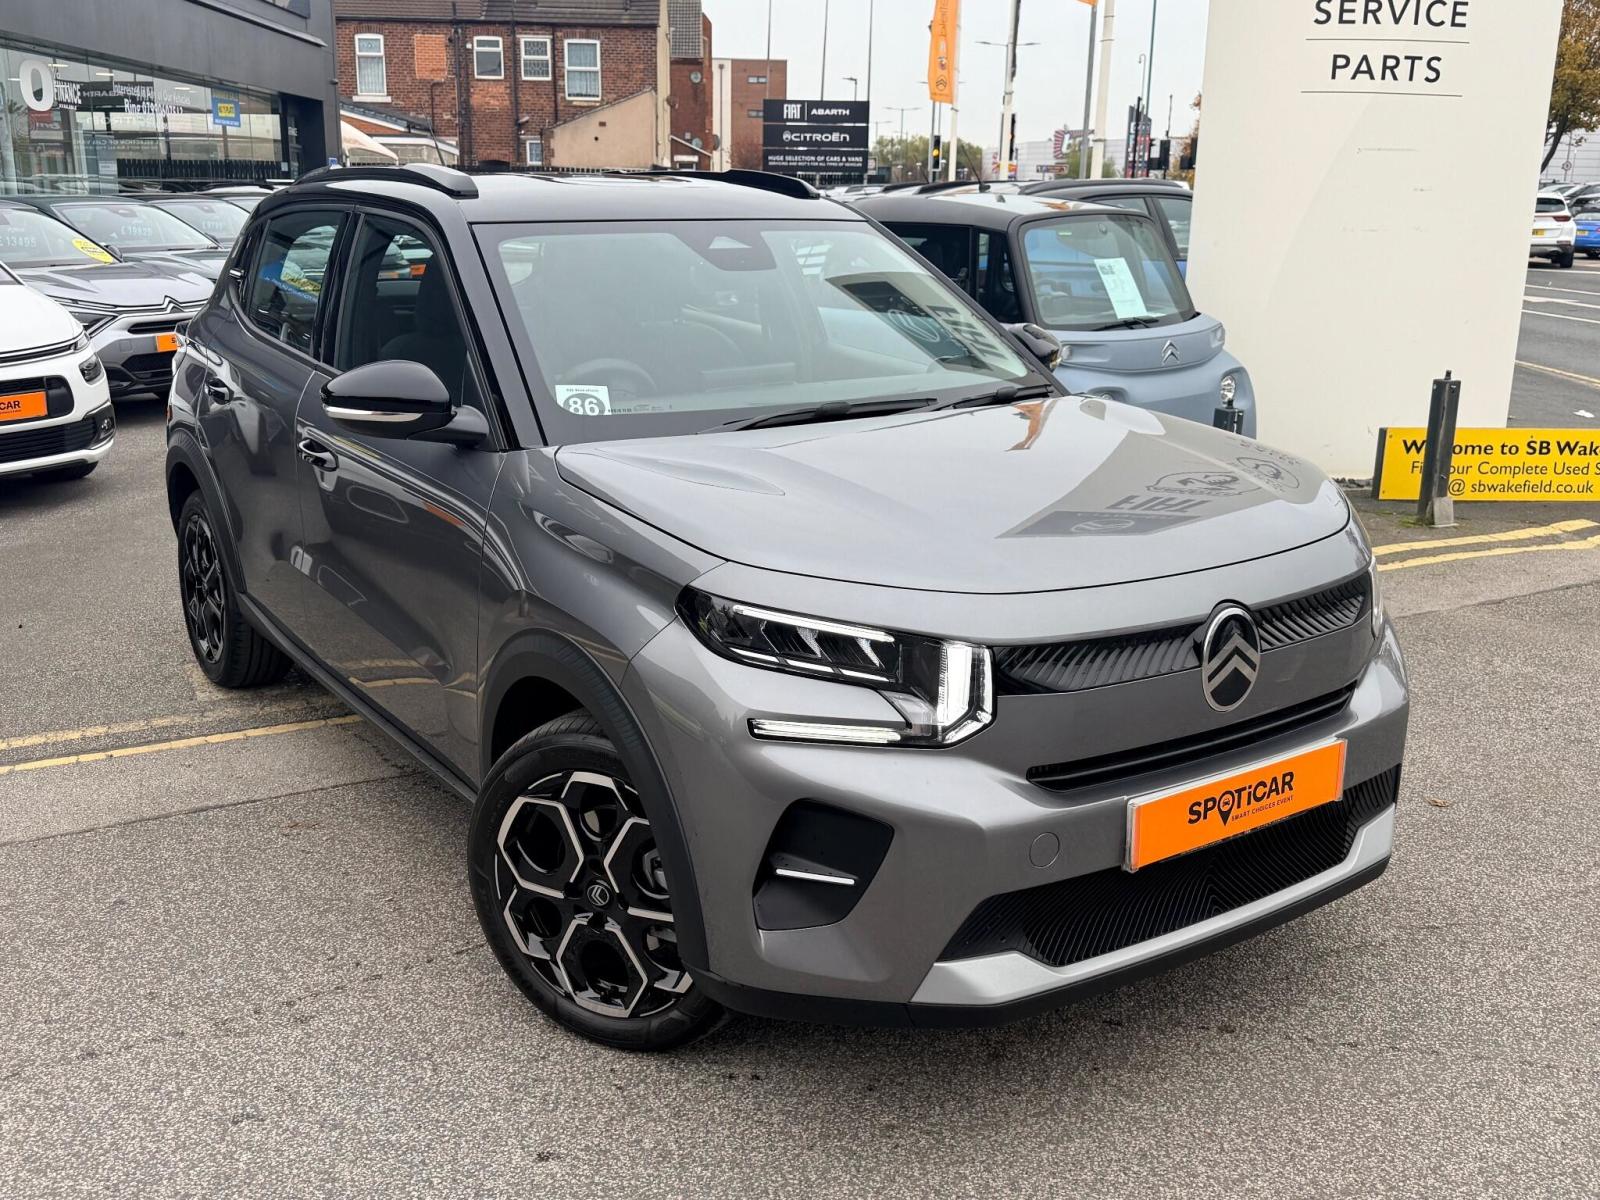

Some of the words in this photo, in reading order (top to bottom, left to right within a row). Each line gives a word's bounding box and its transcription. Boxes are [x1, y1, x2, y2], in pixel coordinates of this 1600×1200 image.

[1313, 0, 1469, 28] SERVICE
[1330, 54, 1442, 83] PARTS
[783, 104, 802, 119] FIAT
[811, 108, 850, 116] ABARTH
[569, 397, 600, 416] 86
[1402, 439, 1494, 456] Wome
[1500, 442, 1519, 456] to
[1526, 440, 1551, 456] SB
[1477, 461, 1548, 479] Complete
[1553, 461, 1590, 475] Used
[1448, 479, 1466, 497] @
[1470, 480, 1594, 494] sbwakefield.co.uk
[1231, 810, 1250, 822] SMART
[1251, 801, 1276, 815] CHOICES
[1276, 795, 1294, 805] EVENT
